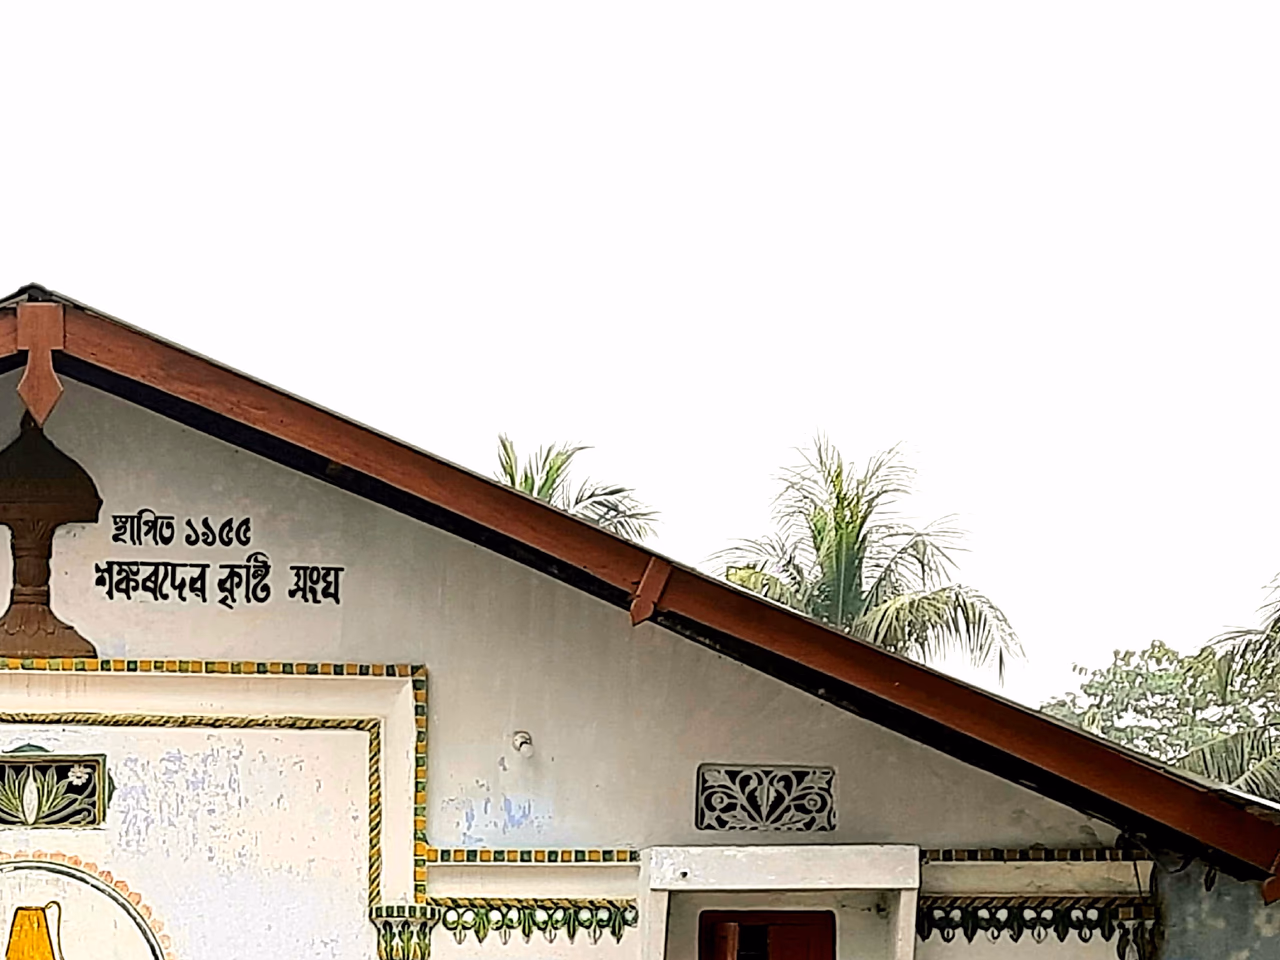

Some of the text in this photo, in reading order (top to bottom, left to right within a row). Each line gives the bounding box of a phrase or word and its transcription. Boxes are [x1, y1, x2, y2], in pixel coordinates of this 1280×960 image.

[111, 508, 251, 547] স্থাপিত ১৯৫৫
[217, 551, 272, 610] কৃষ্টি
